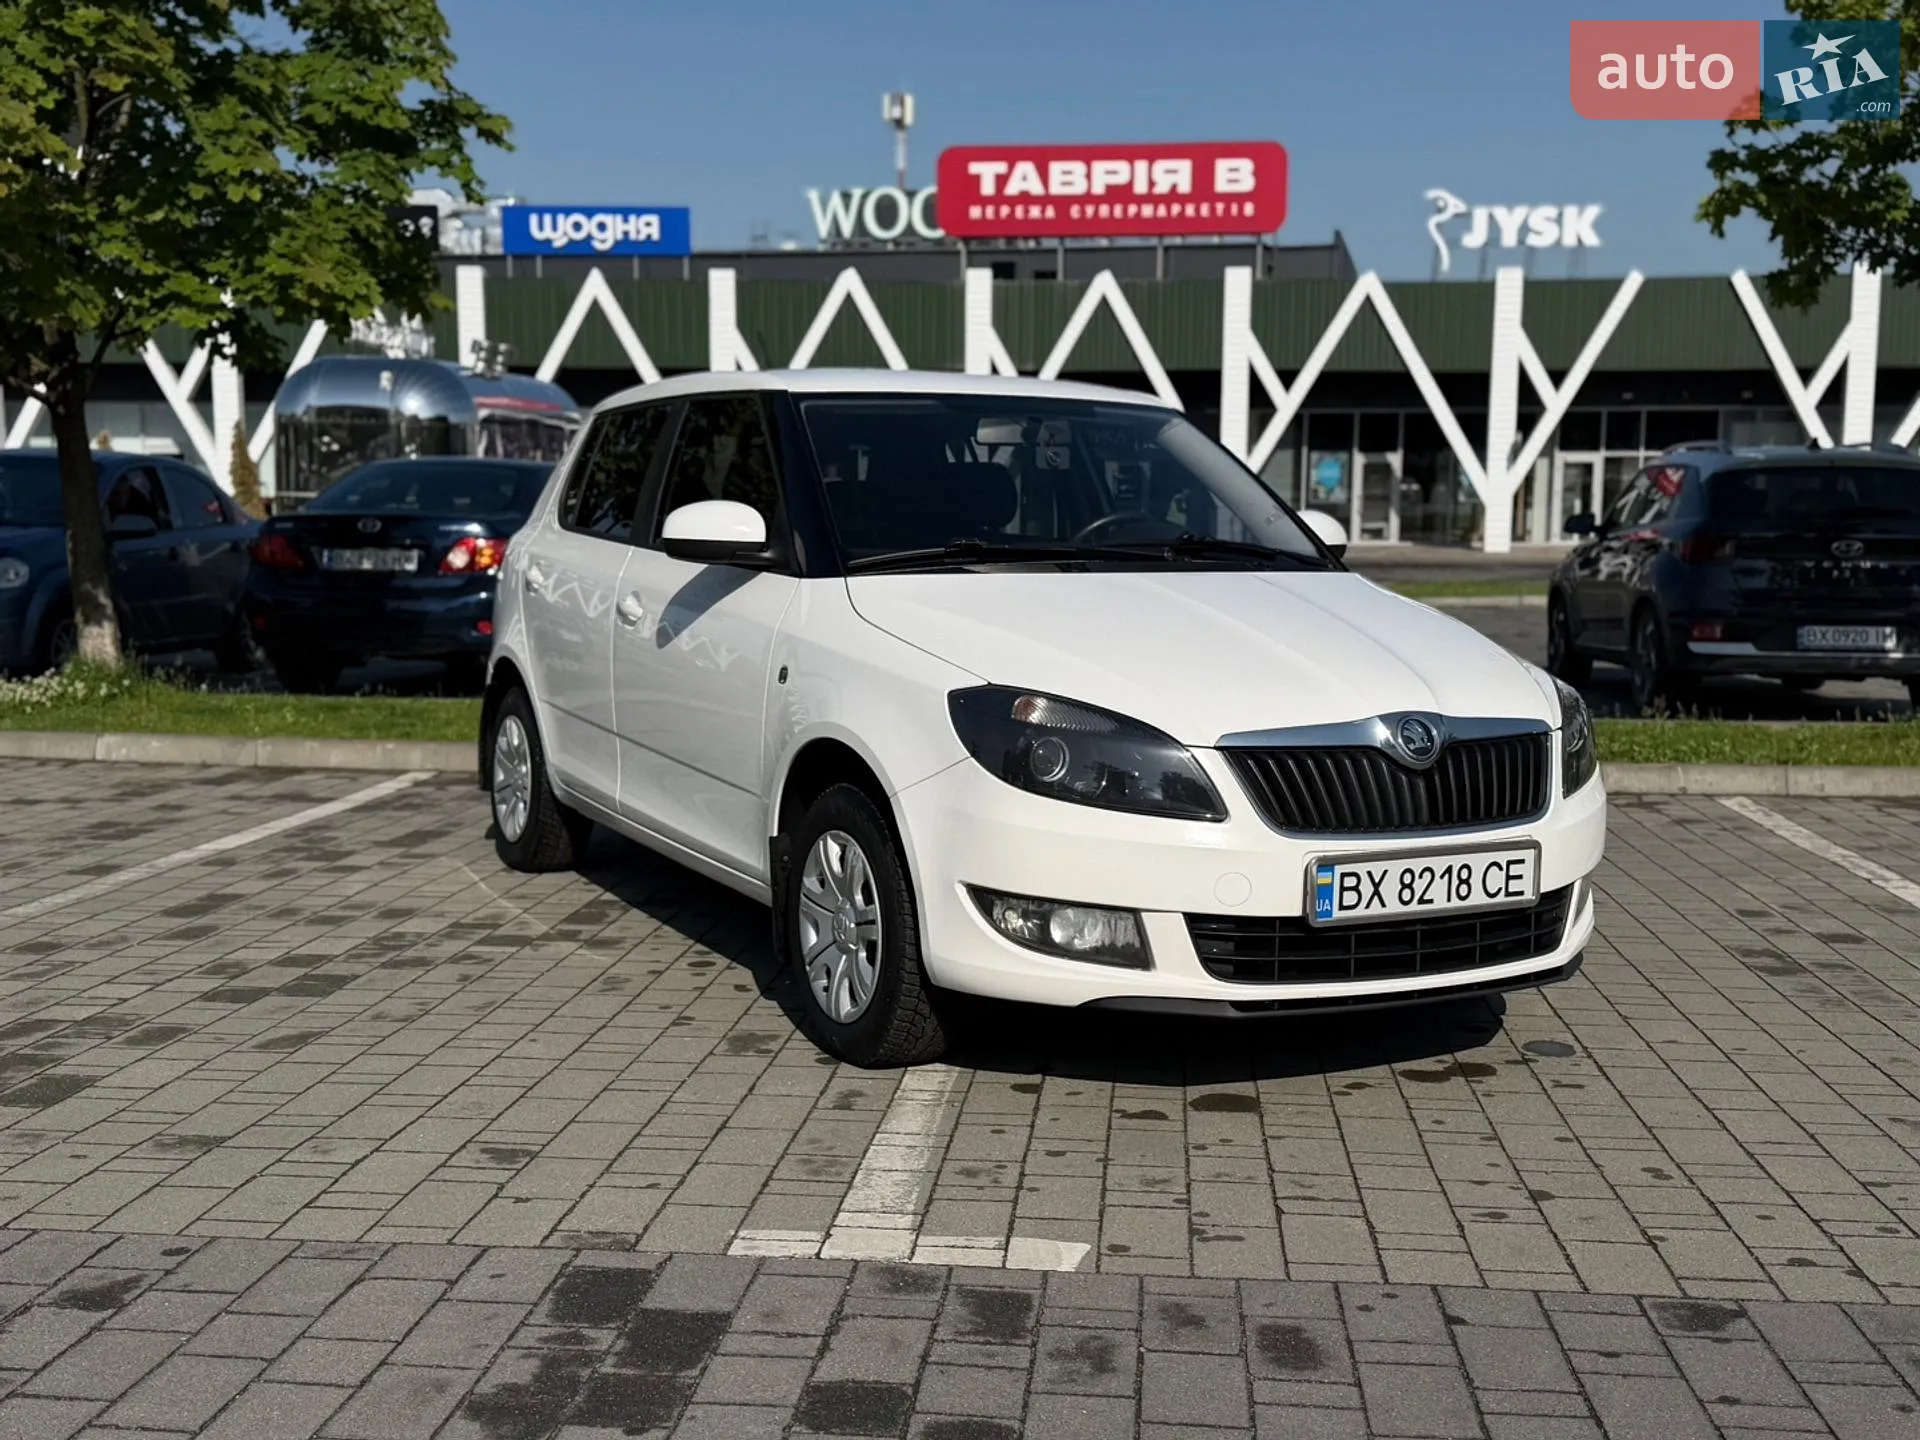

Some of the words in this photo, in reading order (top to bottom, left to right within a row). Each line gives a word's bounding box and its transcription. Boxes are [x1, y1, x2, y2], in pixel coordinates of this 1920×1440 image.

[967, 158, 1193, 196] ТАВРІЯ
[1213, 157, 1256, 194] В
[968, 203, 1056, 220] МЕРЕЖА
[1461, 204, 1603, 249] JYSK
[1338, 868, 1389, 912] BX
[1397, 863, 1473, 907] 8218
[1481, 858, 1526, 900] CE
